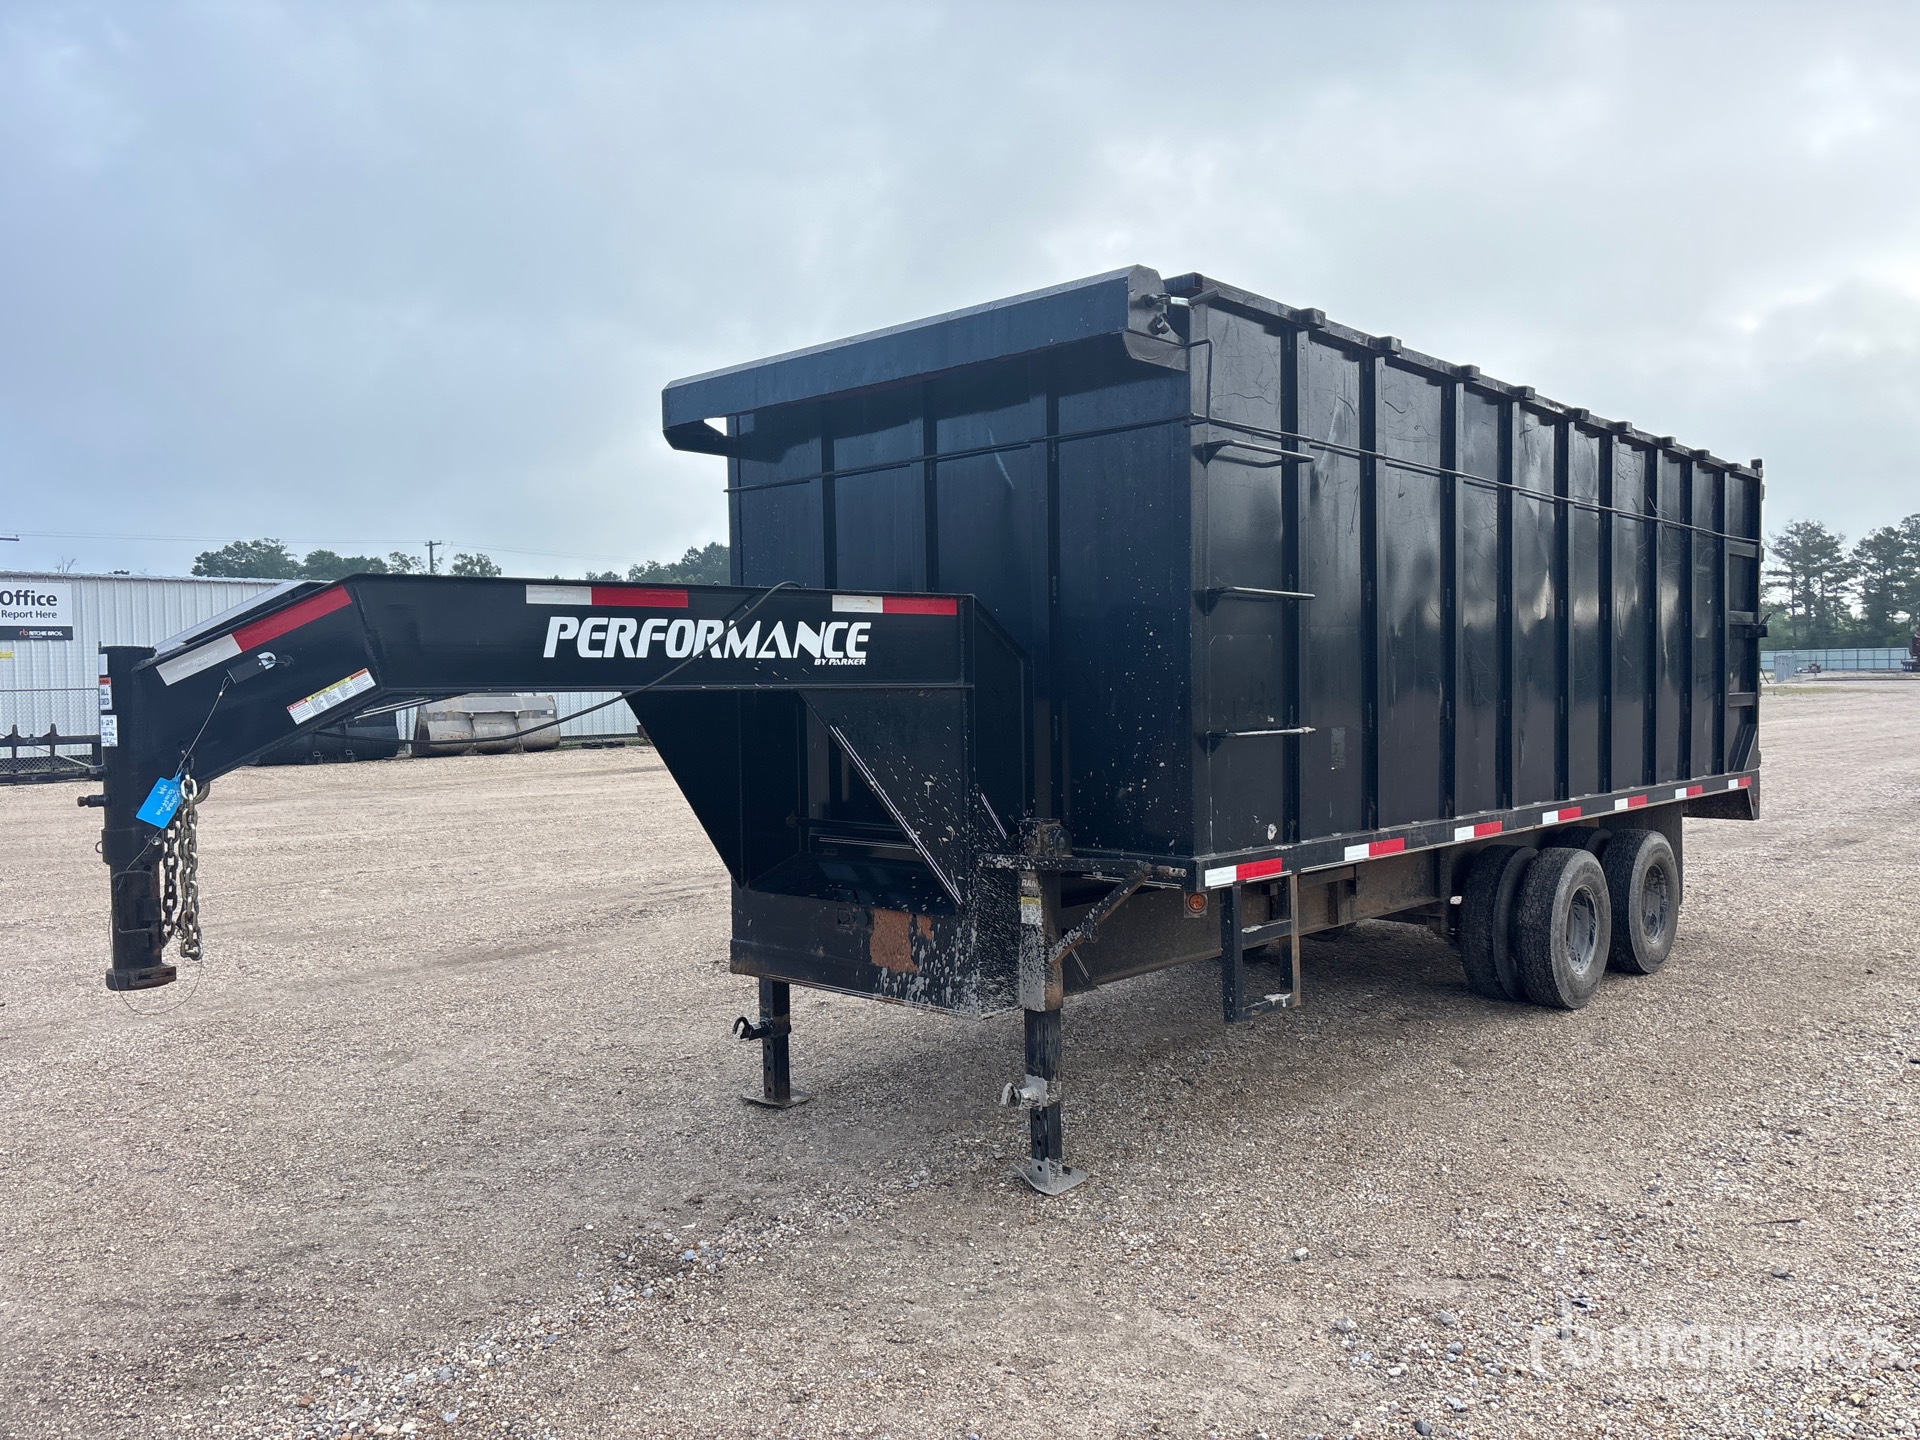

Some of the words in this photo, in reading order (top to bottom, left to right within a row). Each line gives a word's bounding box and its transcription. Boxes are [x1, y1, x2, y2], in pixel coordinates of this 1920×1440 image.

[0, 590, 57, 606] Office
[1, 610, 33, 620] Report
[36, 610, 57, 618] Here
[543, 616, 871, 658] PERFORMANCE
[828, 658, 866, 666] PARKER
